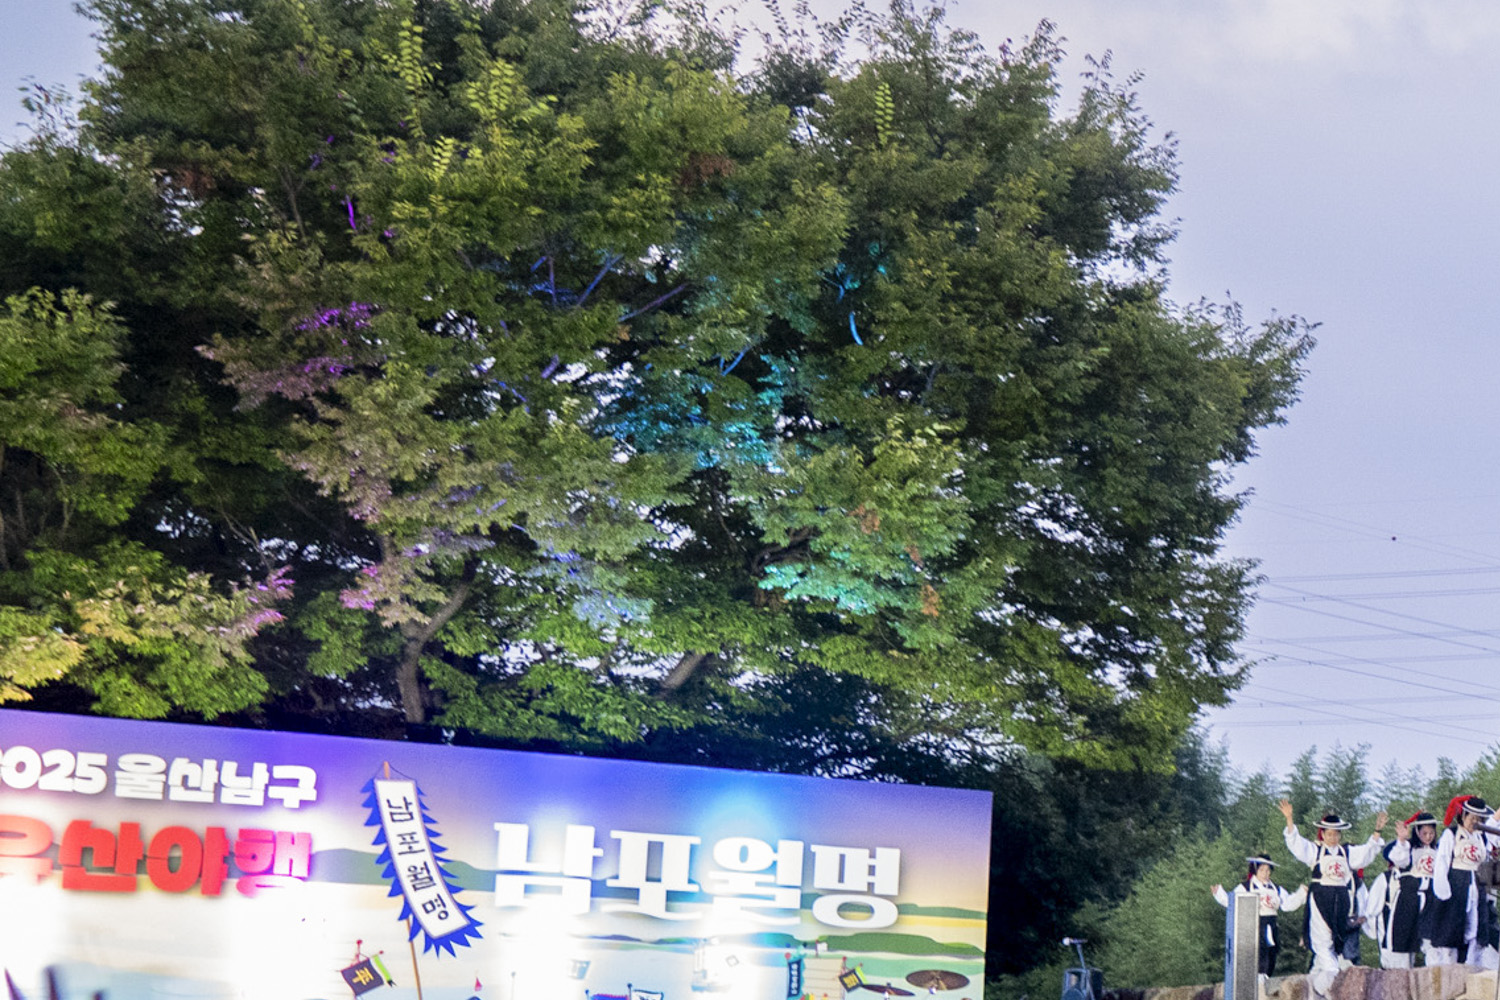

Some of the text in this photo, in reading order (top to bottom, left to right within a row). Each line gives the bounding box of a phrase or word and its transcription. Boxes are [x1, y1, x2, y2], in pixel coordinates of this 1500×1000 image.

[0, 745, 318, 809] 025 울산남구
[386, 796, 450, 921] 남포월명
[493, 822, 901, 930] 남포월명
